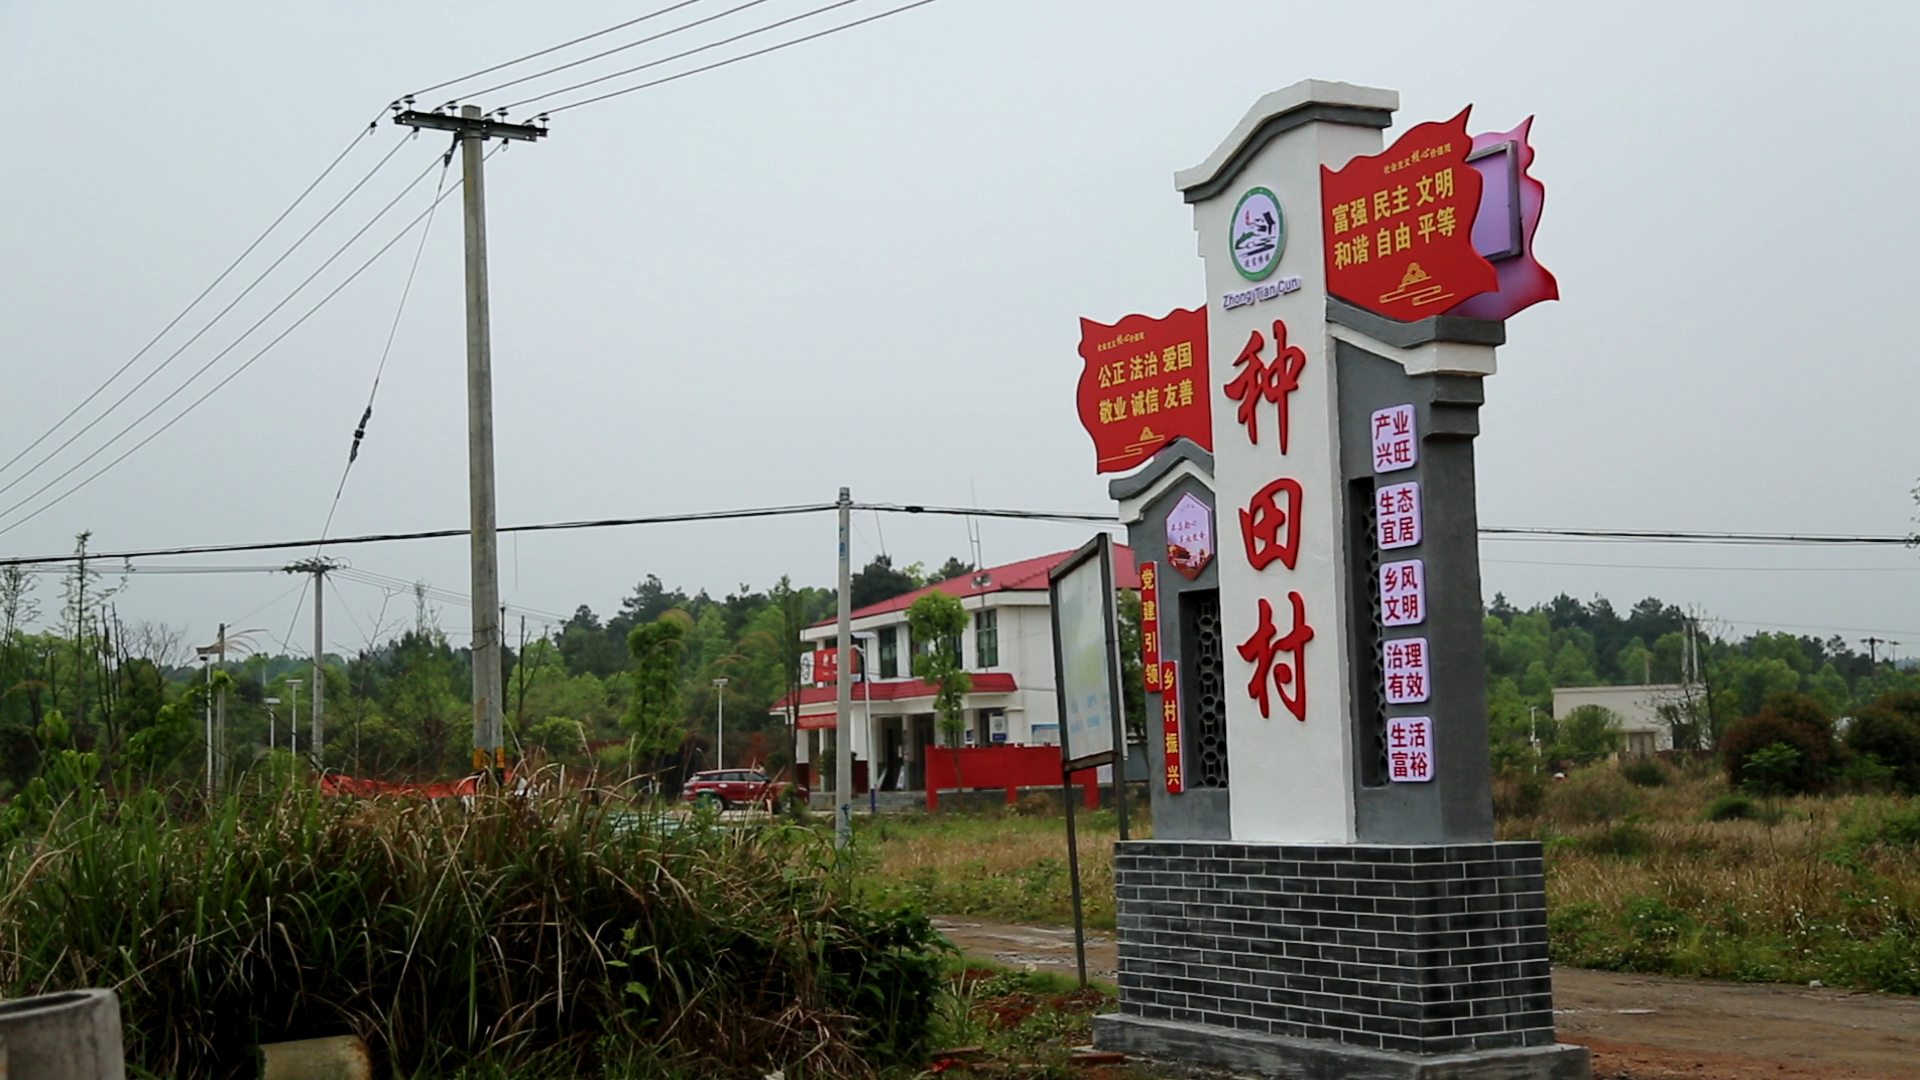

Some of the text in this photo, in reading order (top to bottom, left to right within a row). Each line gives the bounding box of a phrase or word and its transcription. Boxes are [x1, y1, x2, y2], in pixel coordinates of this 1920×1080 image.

[1331, 167, 1455, 236] 富强 民主 文明
[1334, 206, 1456, 270] 和谐 自由 平等
[1222, 277, 1299, 308] Zhong Tian Cun
[1097, 361, 1127, 389] 公正
[1129, 351, 1159, 382] 法治
[1162, 341, 1193, 374] 爱国
[1098, 378, 1194, 425] 敬业 诚信 友善
[1374, 410, 1410, 440] 产业
[1376, 439, 1412, 468] 兴旺
[1379, 487, 1414, 517] 生态
[1223, 318, 1315, 722] 种田村
[1380, 516, 1415, 545] 宜居
[1384, 565, 1419, 593] 乡风
[1384, 594, 1419, 621] 文明
[1141, 568, 1159, 685] 党建引领
[1386, 643, 1423, 670] 治理
[1387, 671, 1425, 699] 有效
[1164, 668, 1180, 786] 乡村振兴
[1391, 722, 1426, 748] 生活
[1391, 751, 1428, 778] 富裕
